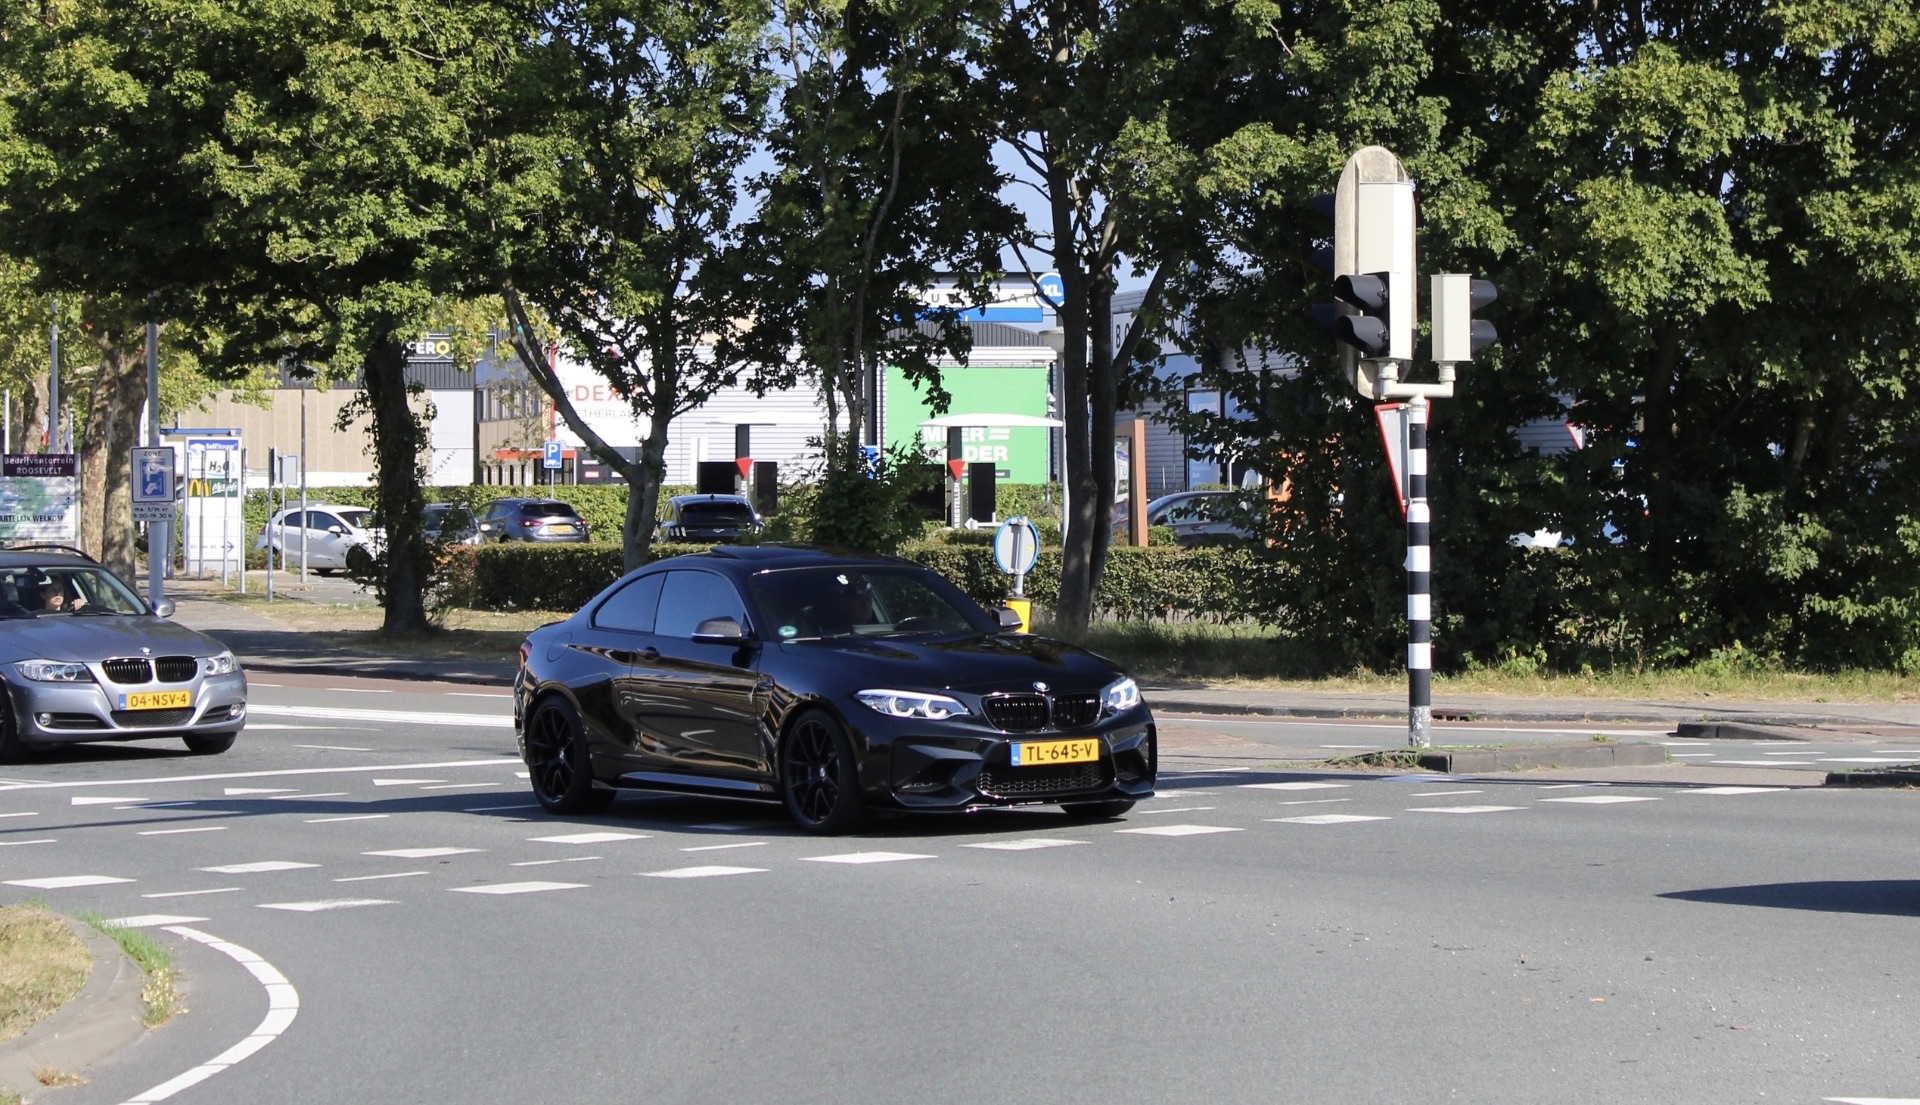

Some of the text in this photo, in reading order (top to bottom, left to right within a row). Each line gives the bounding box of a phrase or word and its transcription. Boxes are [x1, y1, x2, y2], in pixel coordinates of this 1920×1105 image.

[1042, 284, 1062, 297] XL
[406, 341, 449, 355] CERO
[548, 444, 558, 458] P
[4, 457, 74, 465] Bedrijventerrein
[17, 467, 62, 475] ROOSEVELT
[0, 515, 64, 523] ARTELIJK WELKOM
[130, 693, 187, 707] 04-NSV-4
[1026, 743, 1093, 761] TL-645-V
